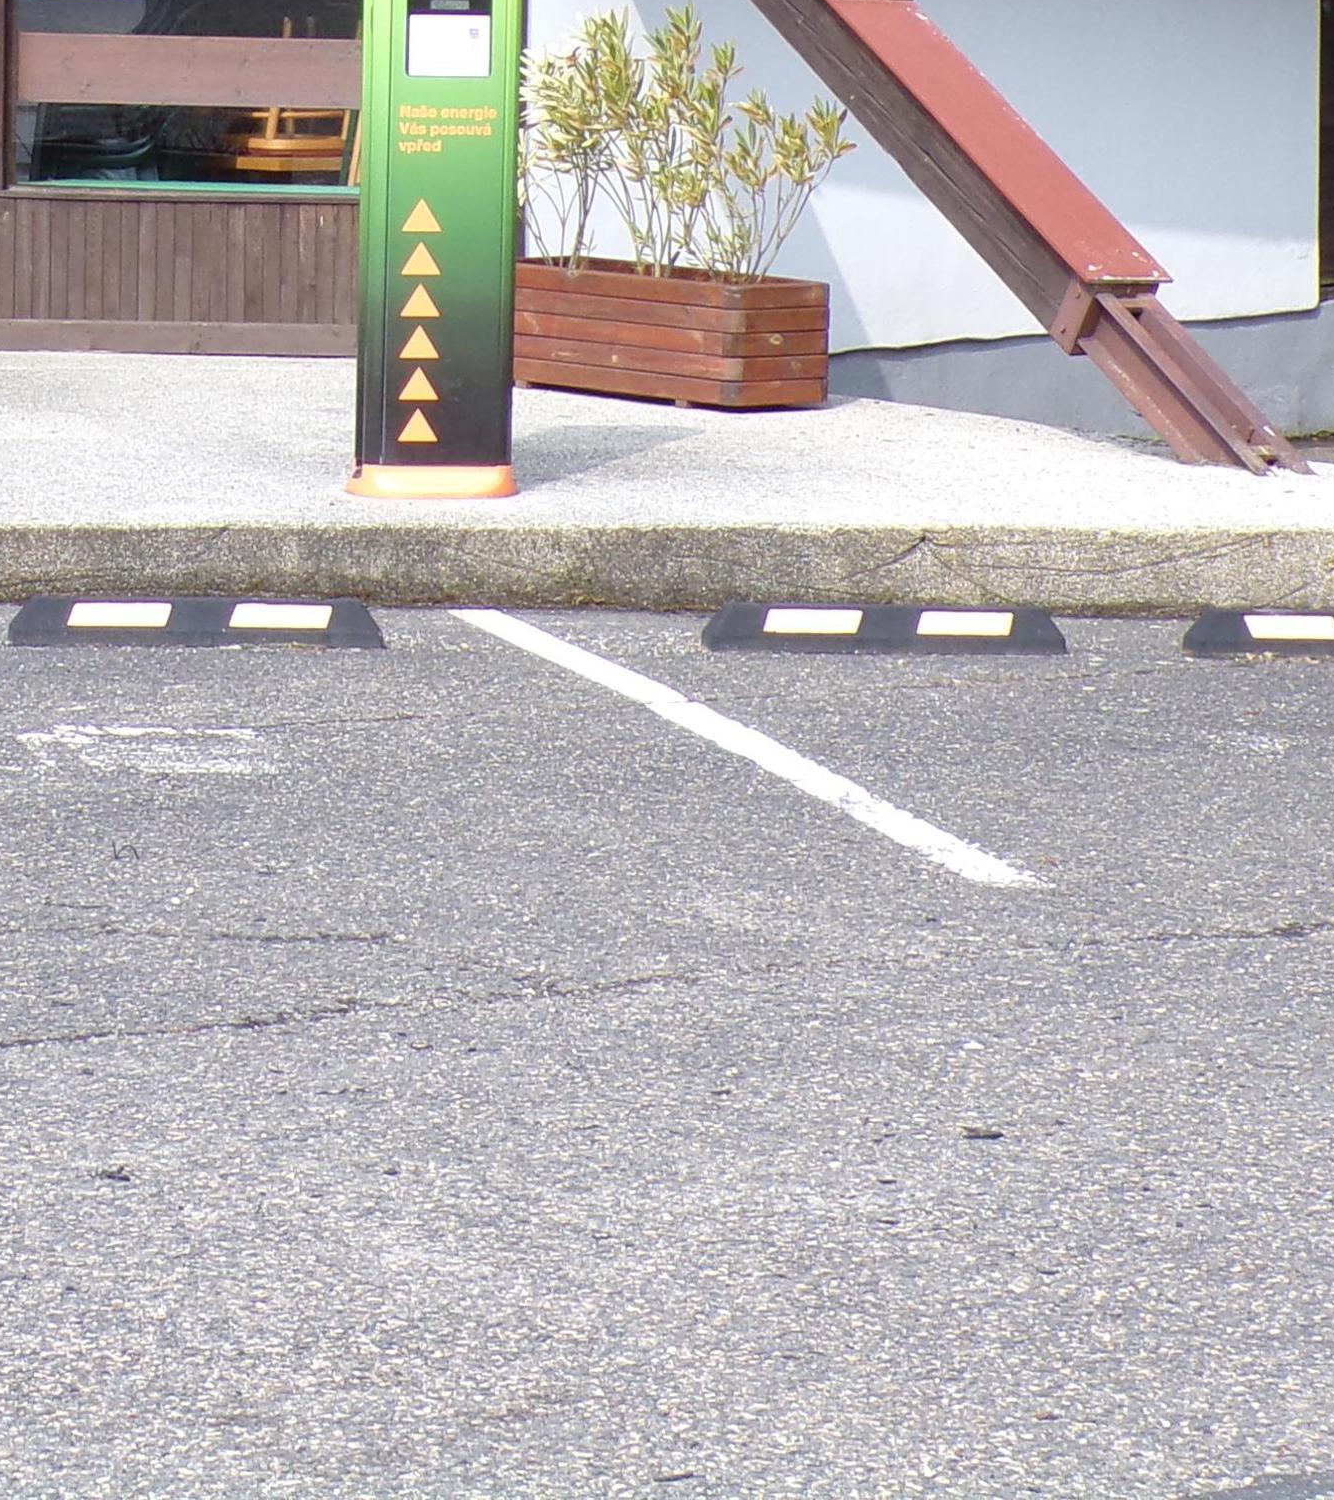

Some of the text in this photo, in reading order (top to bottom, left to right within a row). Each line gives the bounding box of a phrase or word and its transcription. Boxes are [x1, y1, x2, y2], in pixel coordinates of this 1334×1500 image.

[399, 105, 497, 121] Naše energie
[398, 122, 492, 137] Vás posouvá
[398, 139, 443, 154] vpřed
